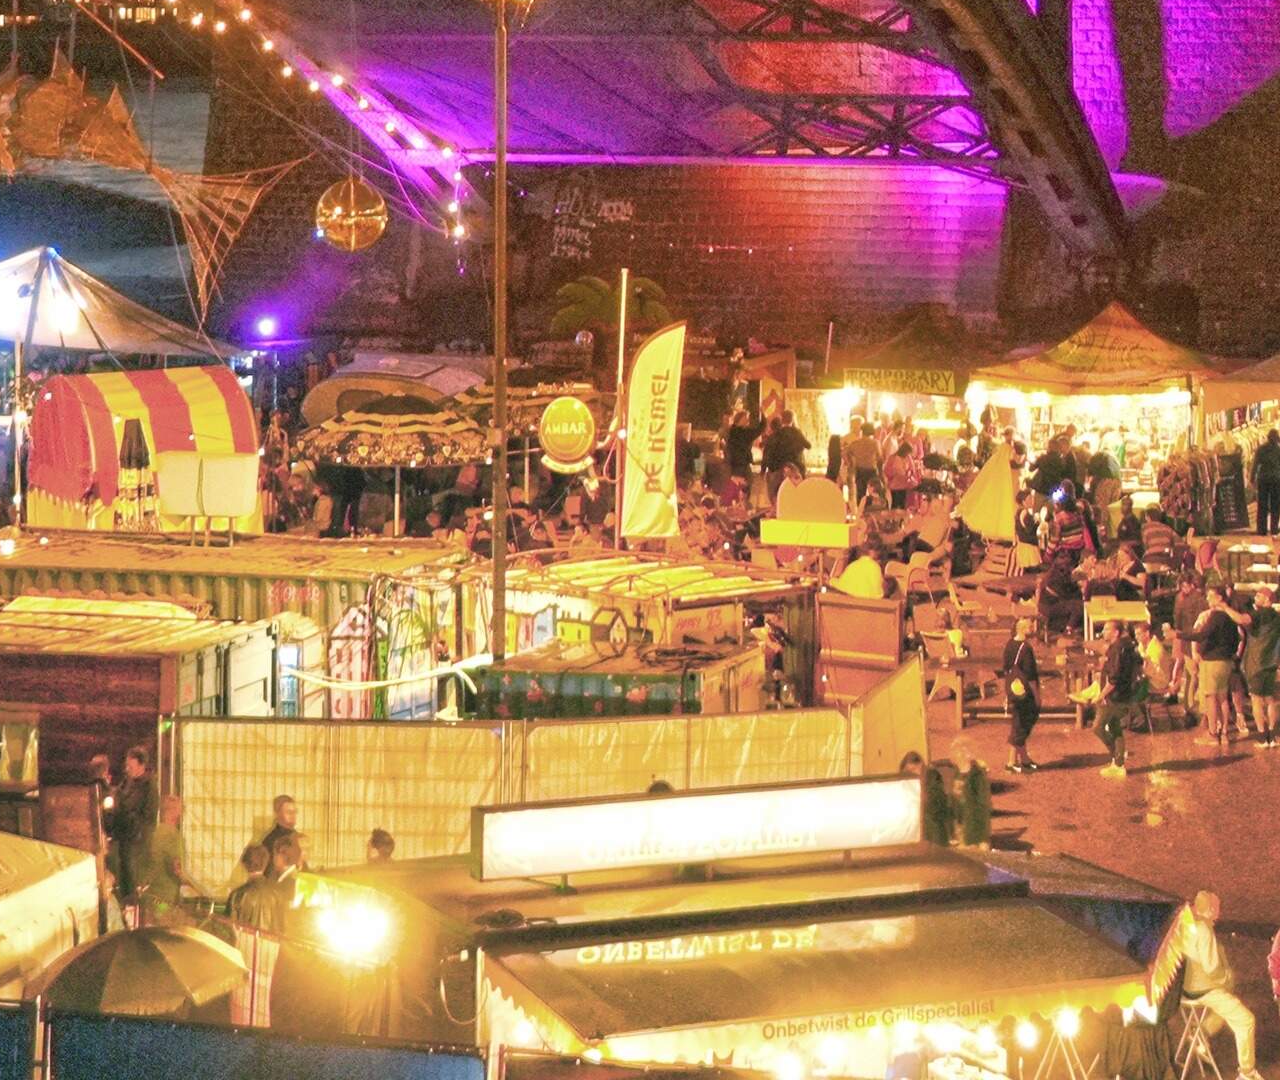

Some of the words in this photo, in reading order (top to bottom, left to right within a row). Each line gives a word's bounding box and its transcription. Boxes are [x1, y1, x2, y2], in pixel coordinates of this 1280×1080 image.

[545, 421, 588, 436] AMBAR
[648, 369, 670, 452] HEMEL
[644, 463, 664, 493] DE
[762, 1016, 850, 1041] Onbetwist
[855, 1012, 875, 1028] de
[882, 999, 995, 1027] Grillspecialist
